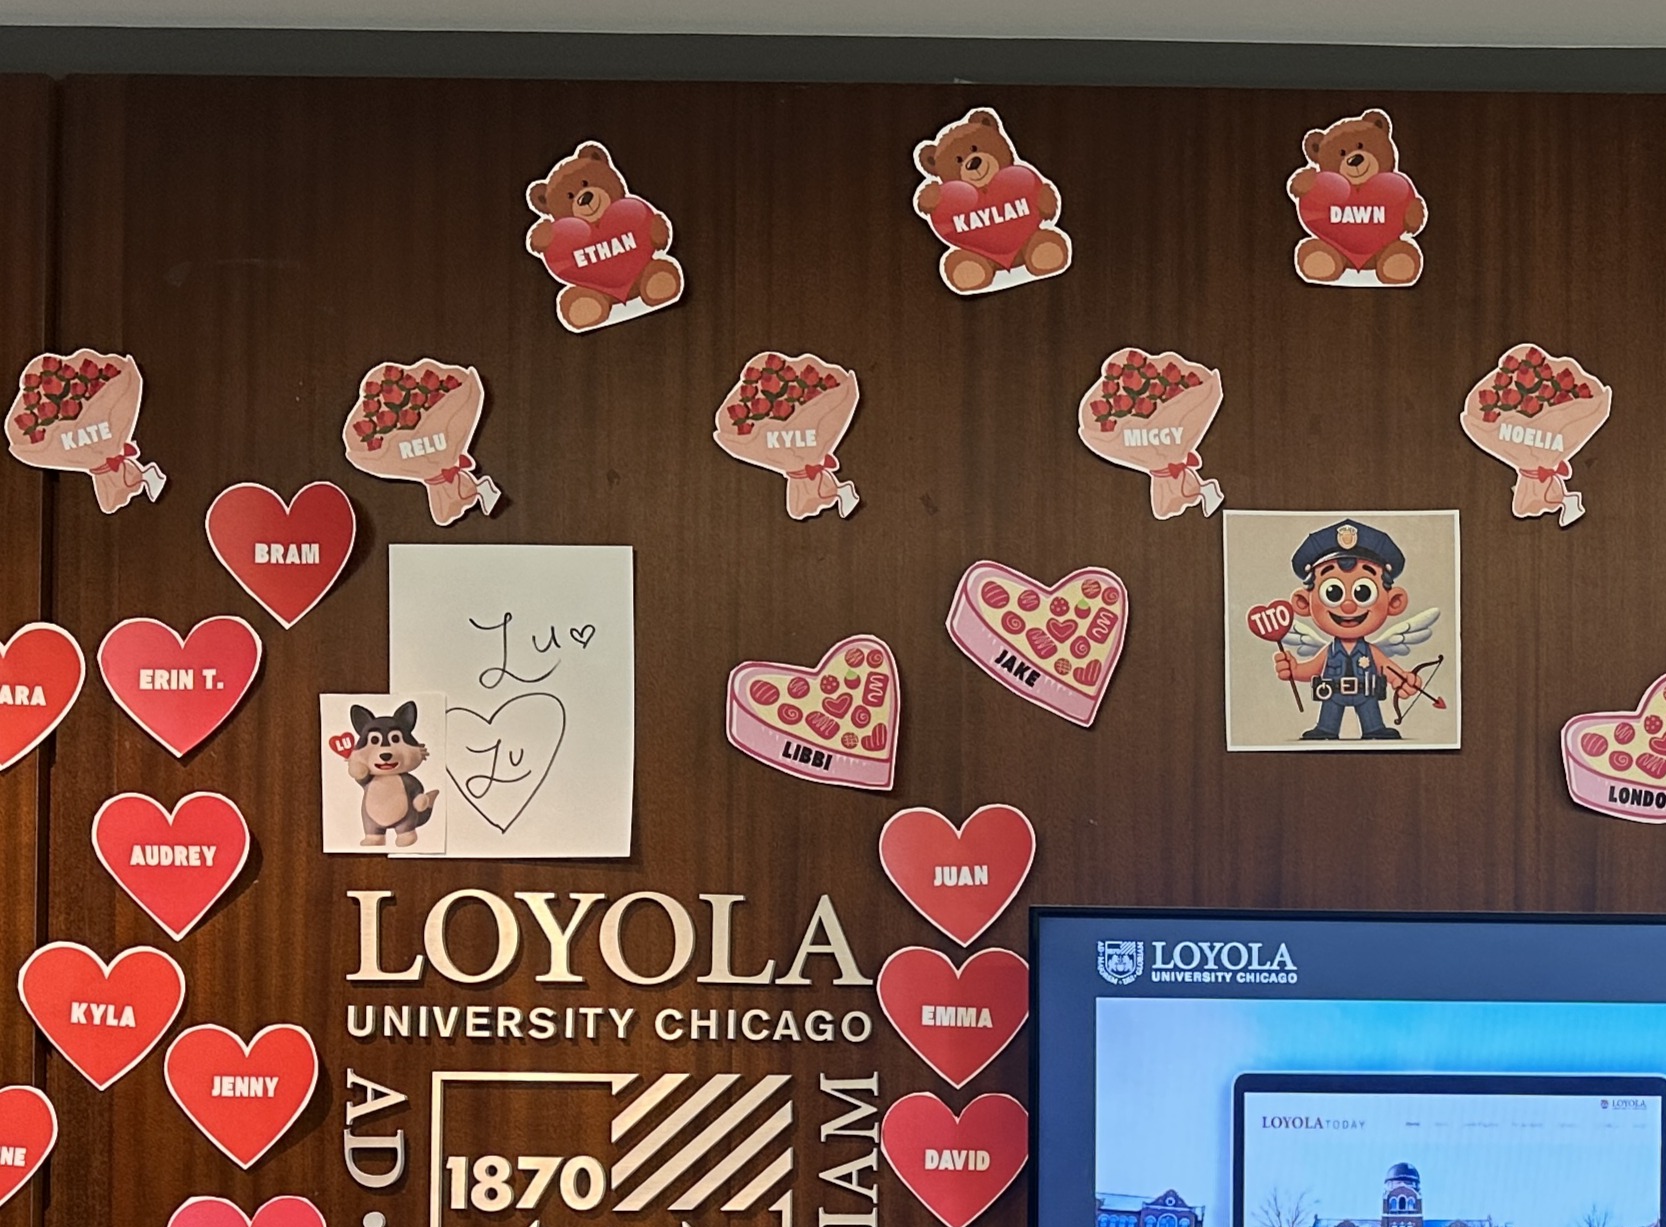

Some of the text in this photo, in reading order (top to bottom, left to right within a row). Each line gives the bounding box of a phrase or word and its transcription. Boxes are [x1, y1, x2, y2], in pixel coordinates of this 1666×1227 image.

[953, 198, 1030, 234] KAYLAH
[1329, 204, 1386, 226] DAWN
[573, 231, 637, 268] ETHAN
[61, 422, 112, 450] KATE
[400, 433, 447, 460] RELU
[766, 429, 817, 448] KYLE
[1123, 427, 1184, 446] MIGGY
[1498, 424, 1564, 452] NOELIA
[254, 543, 320, 565] BRAM
[1251, 605, 1290, 635] TITO
[469, 612, 562, 688] Lu
[139, 669, 224, 690] ERIN T.
[993, 648, 1042, 690] JAKE
[0, 684, 46, 706] ARA
[335, 738, 351, 751] LU
[782, 741, 833, 771] LIBBI
[466, 739, 531, 798] Lu
[130, 845, 216, 867] AUDREY
[934, 865, 988, 886] JUAN
[346, 889, 873, 986] LOYOLA
[1152, 941, 1297, 970] LOYOLA
[1152, 971, 1298, 984] UNIVERSITY CHICAGO
[71, 1002, 136, 1027] KYLA
[347, 1005, 872, 1043] UNIVERSITY CHICAGO
[921, 1006, 992, 1029] EMMA
[211, 1076, 279, 1098] JENNY
[344, 1068, 408, 1188] AD
[0, 1146, 26, 1167] NE
[924, 1149, 990, 1171] DAVID
[446, 1155, 605, 1212] 1870
